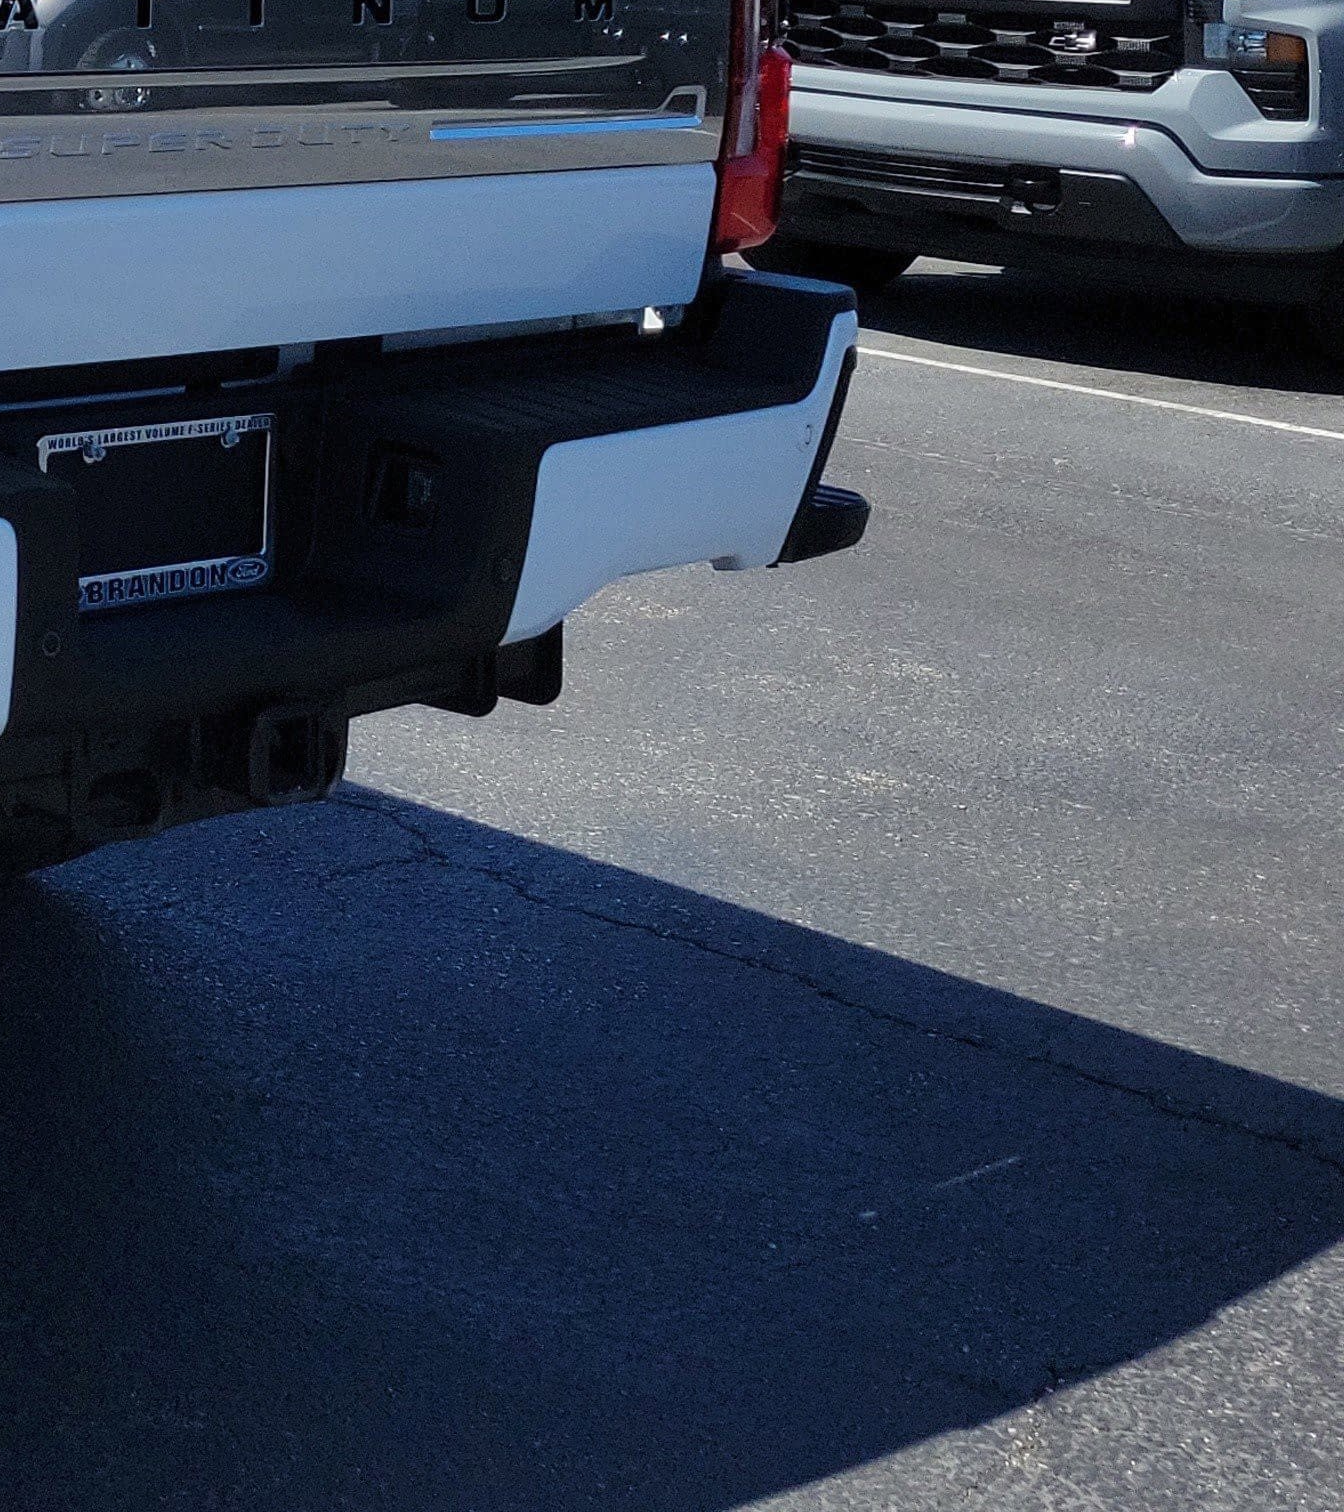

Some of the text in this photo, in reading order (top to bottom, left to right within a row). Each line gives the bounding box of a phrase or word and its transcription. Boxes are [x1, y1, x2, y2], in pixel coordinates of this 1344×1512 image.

[250, 121, 411, 149] DUTY
[98, 430, 143, 447] LARGEST
[145, 425, 185, 439] VOLUME
[85, 562, 229, 604] BRANDON
